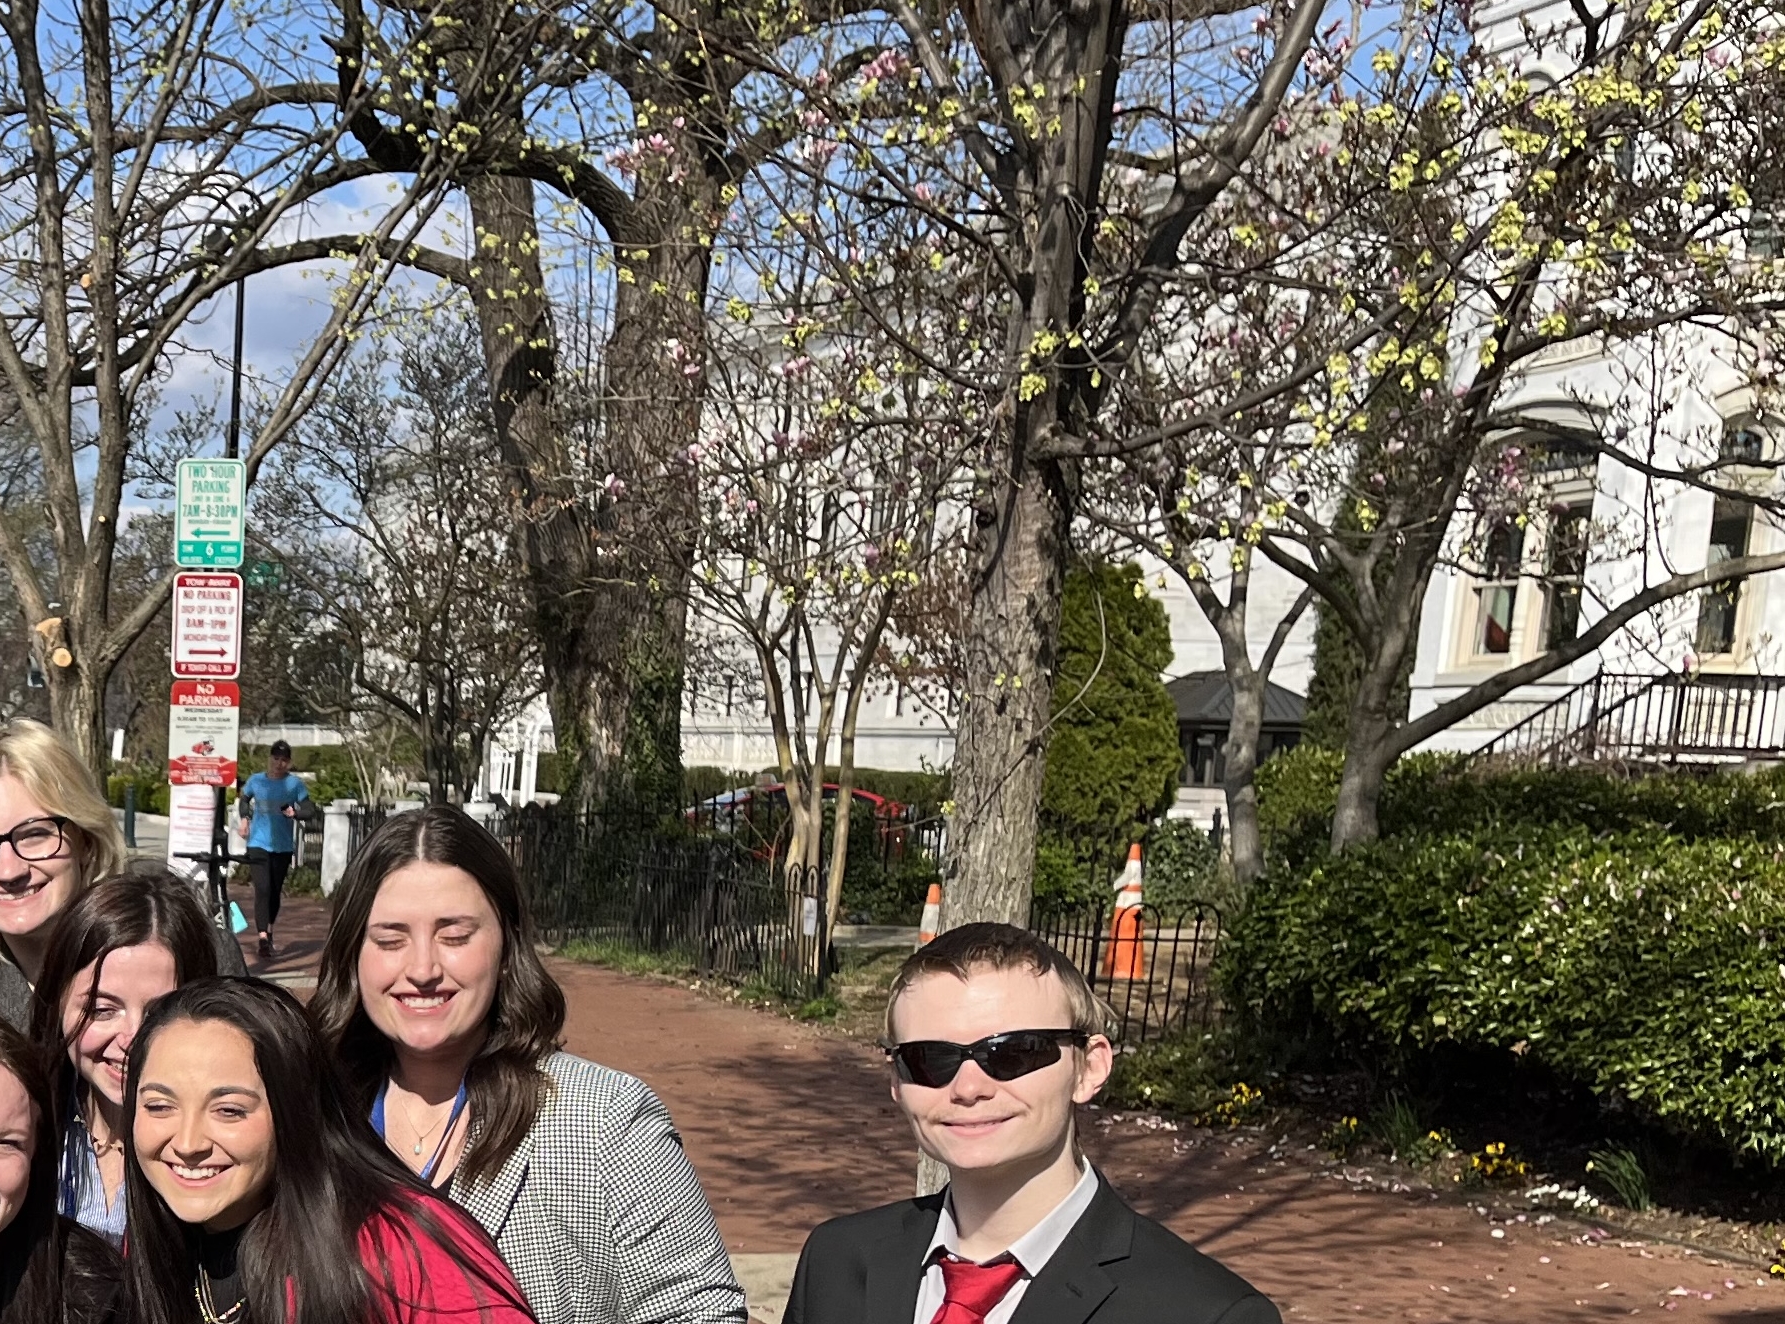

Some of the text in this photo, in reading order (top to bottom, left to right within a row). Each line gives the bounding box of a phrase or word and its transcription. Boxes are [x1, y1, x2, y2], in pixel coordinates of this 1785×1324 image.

[187, 465, 236, 478] TWO HOUR
[192, 480, 230, 493] PARKING
[205, 542, 214, 557] 6
[183, 590, 231, 600] NO PARKING
[196, 683, 215, 694] NO
[179, 695, 232, 706] PARKING
